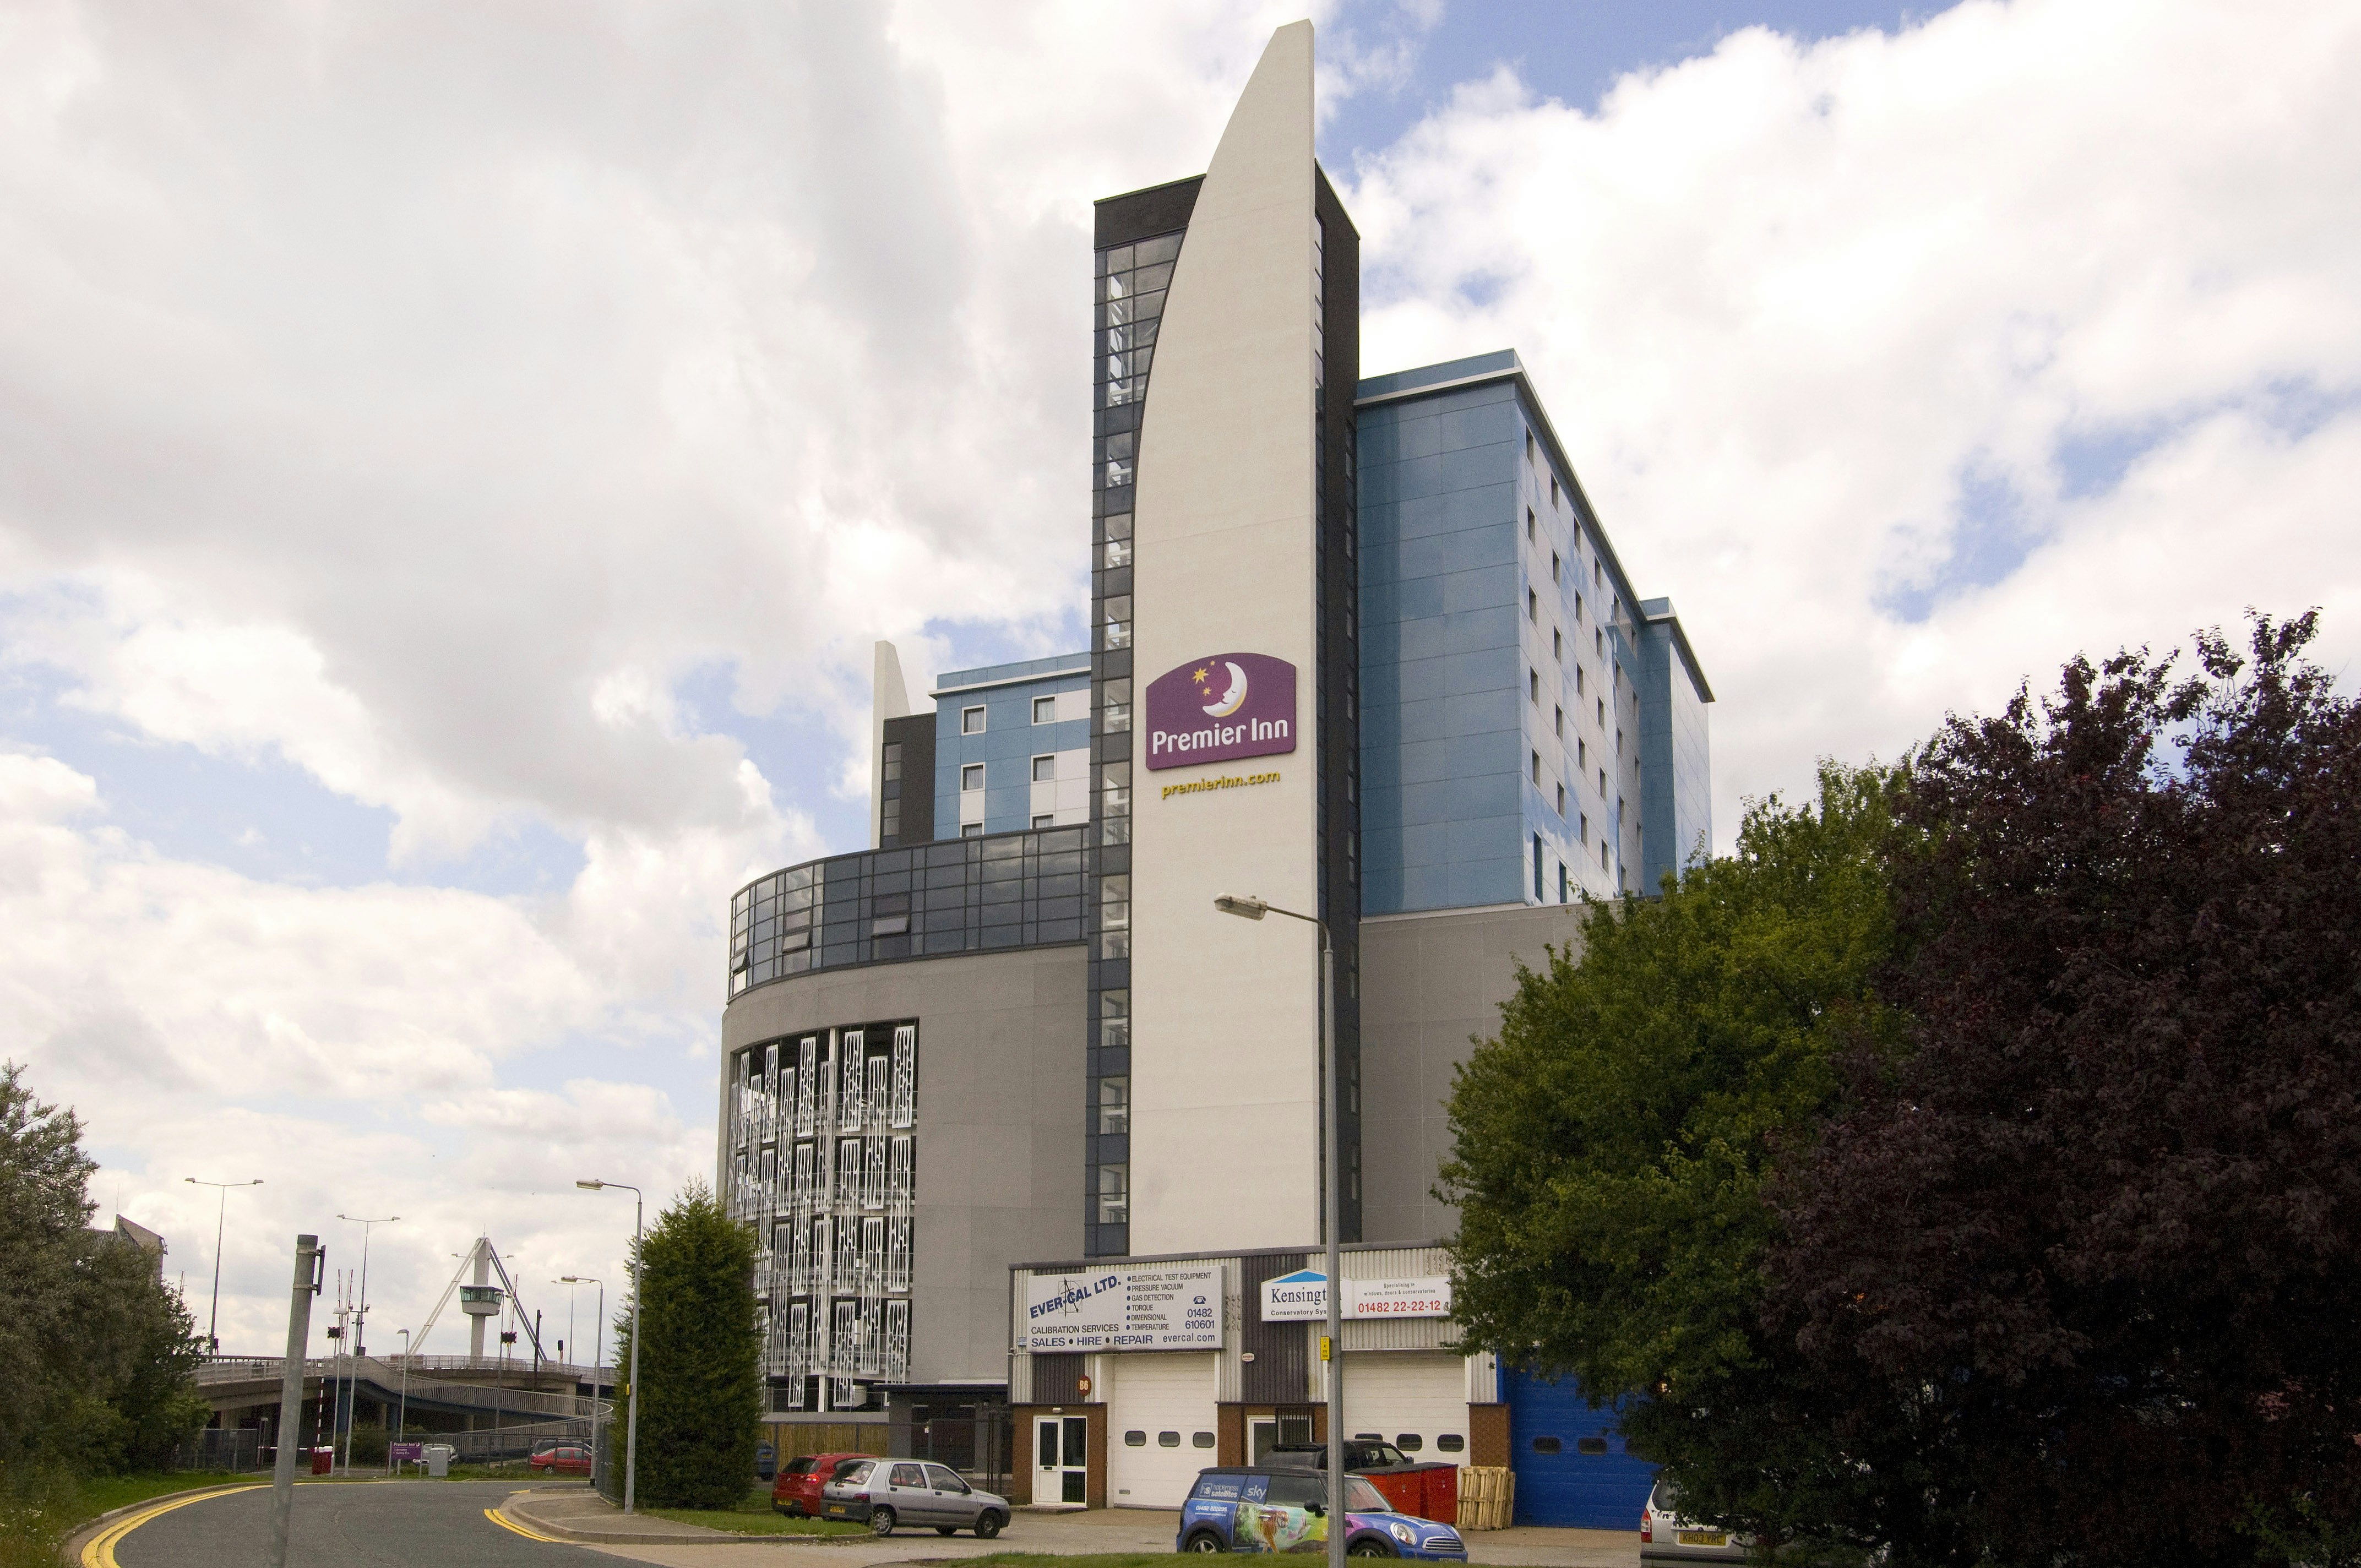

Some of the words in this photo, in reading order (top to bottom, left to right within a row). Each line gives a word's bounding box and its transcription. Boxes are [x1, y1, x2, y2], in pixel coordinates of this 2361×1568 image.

[1152, 723, 1247, 754] Premier
[1252, 718, 1288, 741] Inn
[1161, 771, 1280, 799] premierinn.com
[1030, 1287, 1092, 1319] EVER-CAL
[1094, 1276, 1121, 1294] LTD.
[1271, 1287, 1342, 1305] Kensingt
[1187, 1308, 1212, 1317] 01482
[1358, 1302, 1390, 1313] 01482
[1393, 1300, 1440, 1311] 22-22-12
[1031, 1325, 1080, 1334] CALIBRATION
[1082, 1324, 1119, 1333] SERVICES
[1185, 1320, 1215, 1329] 610601
[1031, 1337, 1065, 1347] SALES
[1077, 1336, 1102, 1346] HIRE
[1114, 1335, 1153, 1345] REPAIR
[1163, 1333, 1215, 1342] evercal.com
[1080, 1380, 1089, 1390] B6
[1247, 1484, 1267, 1500] sky
